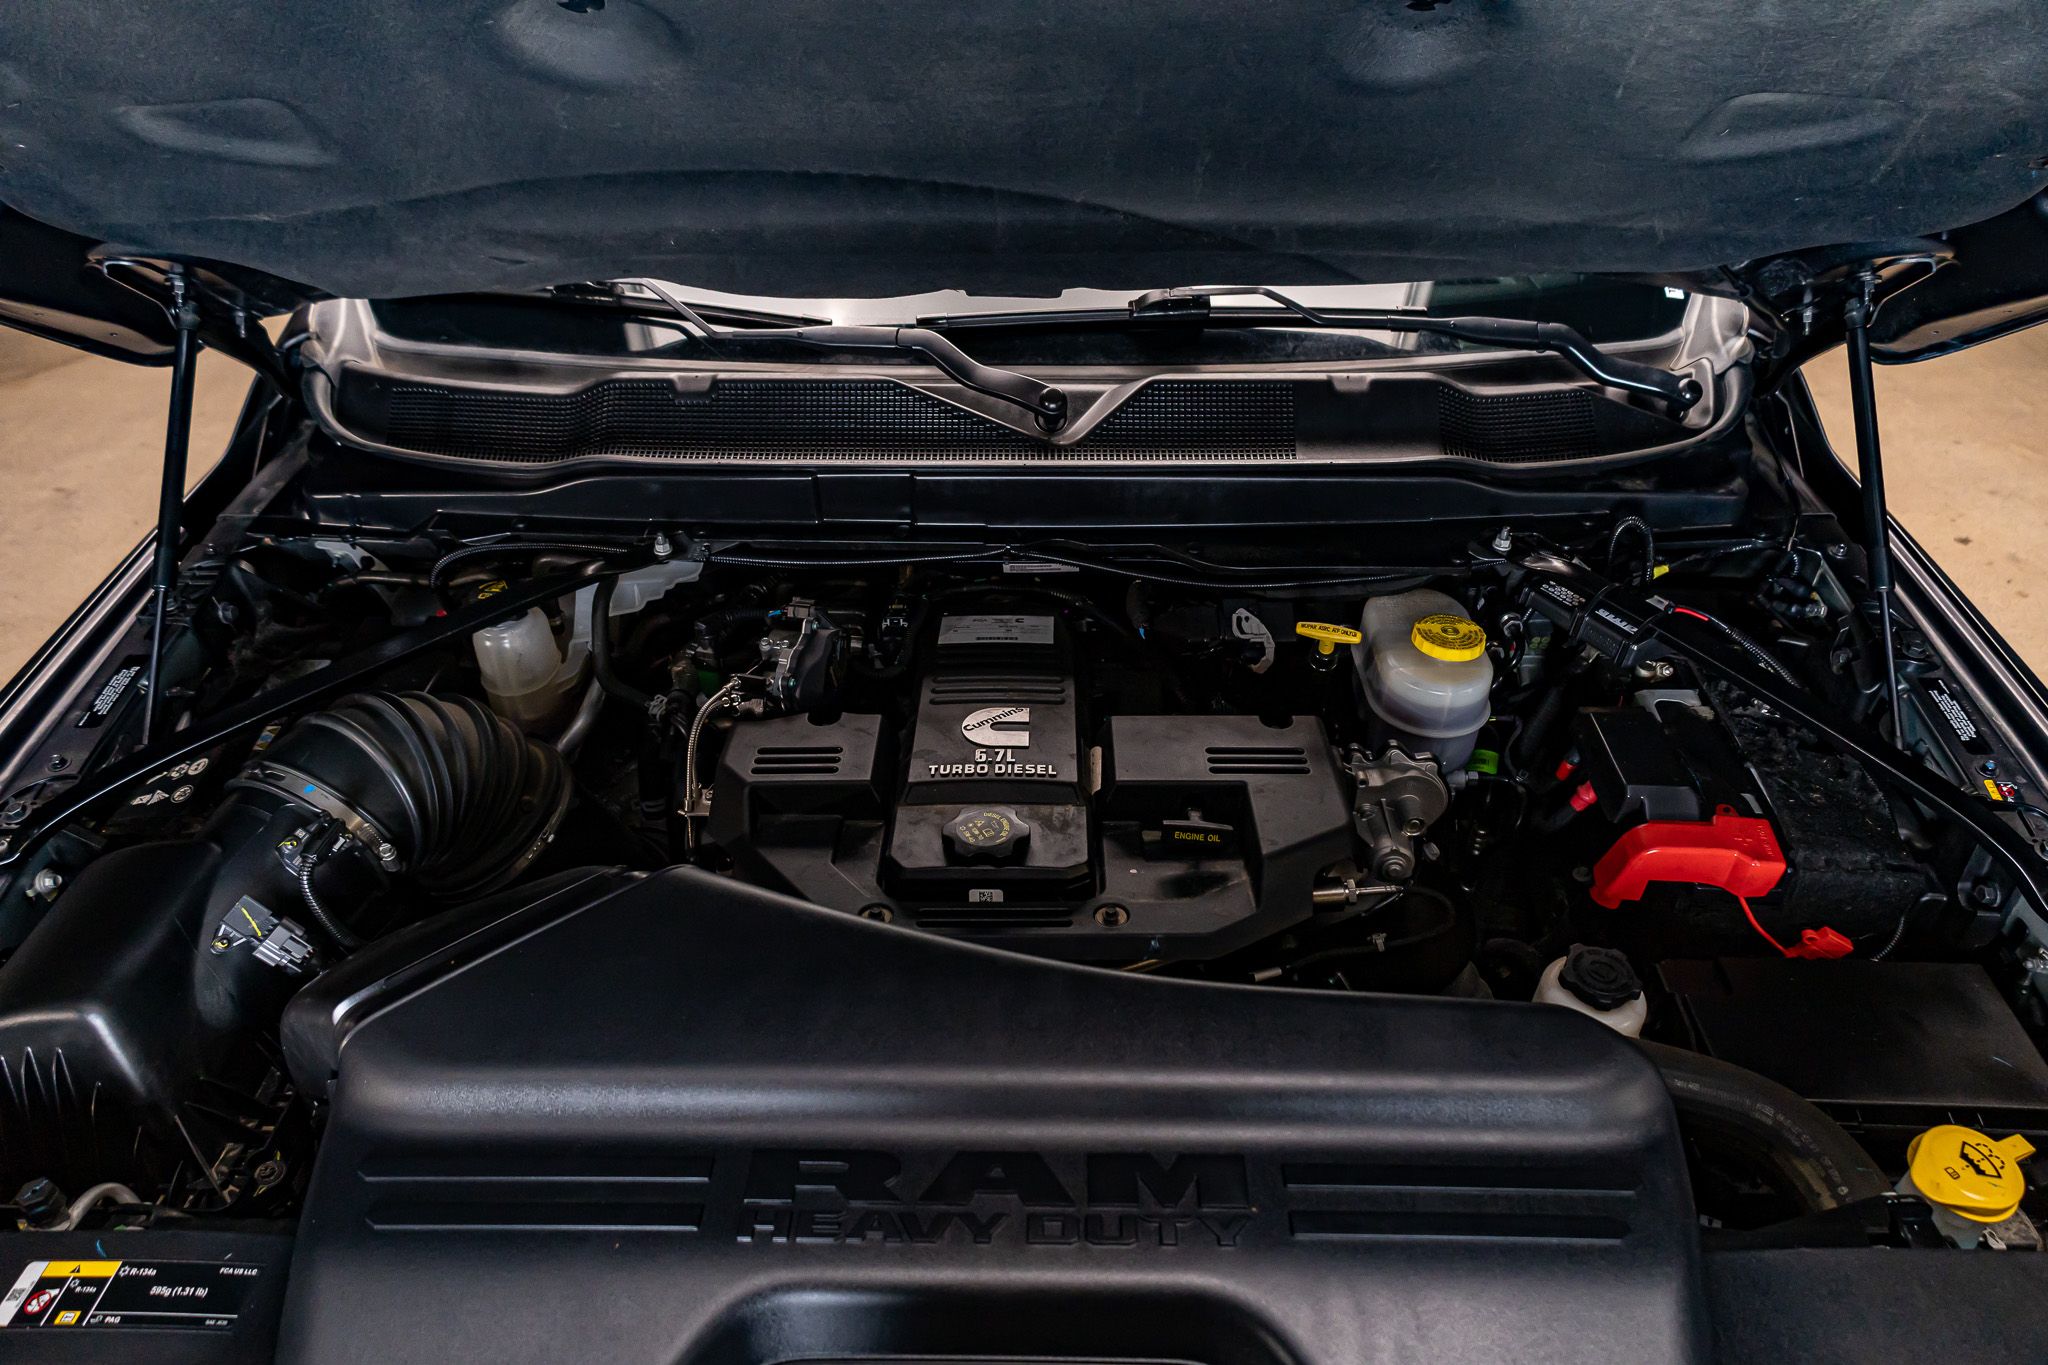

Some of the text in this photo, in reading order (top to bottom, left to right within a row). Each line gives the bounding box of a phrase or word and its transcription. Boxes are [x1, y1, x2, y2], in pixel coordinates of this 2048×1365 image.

[963, 707, 1024, 732] Cummins
[974, 748, 1016, 763] 6.7L
[928, 763, 1057, 776] TURBO DIESEL
[1174, 831, 1221, 842] ENGINE OIL
[744, 1150, 1249, 1209] RAM
[737, 1210, 1250, 1247] HEAVY DUTY
[129, 1267, 157, 1276] R-134a
[219, 1267, 233, 1275] FCA
[244, 1268, 258, 1276] LLC
[149, 1286, 208, 1298] 595g (1.31 lb)
